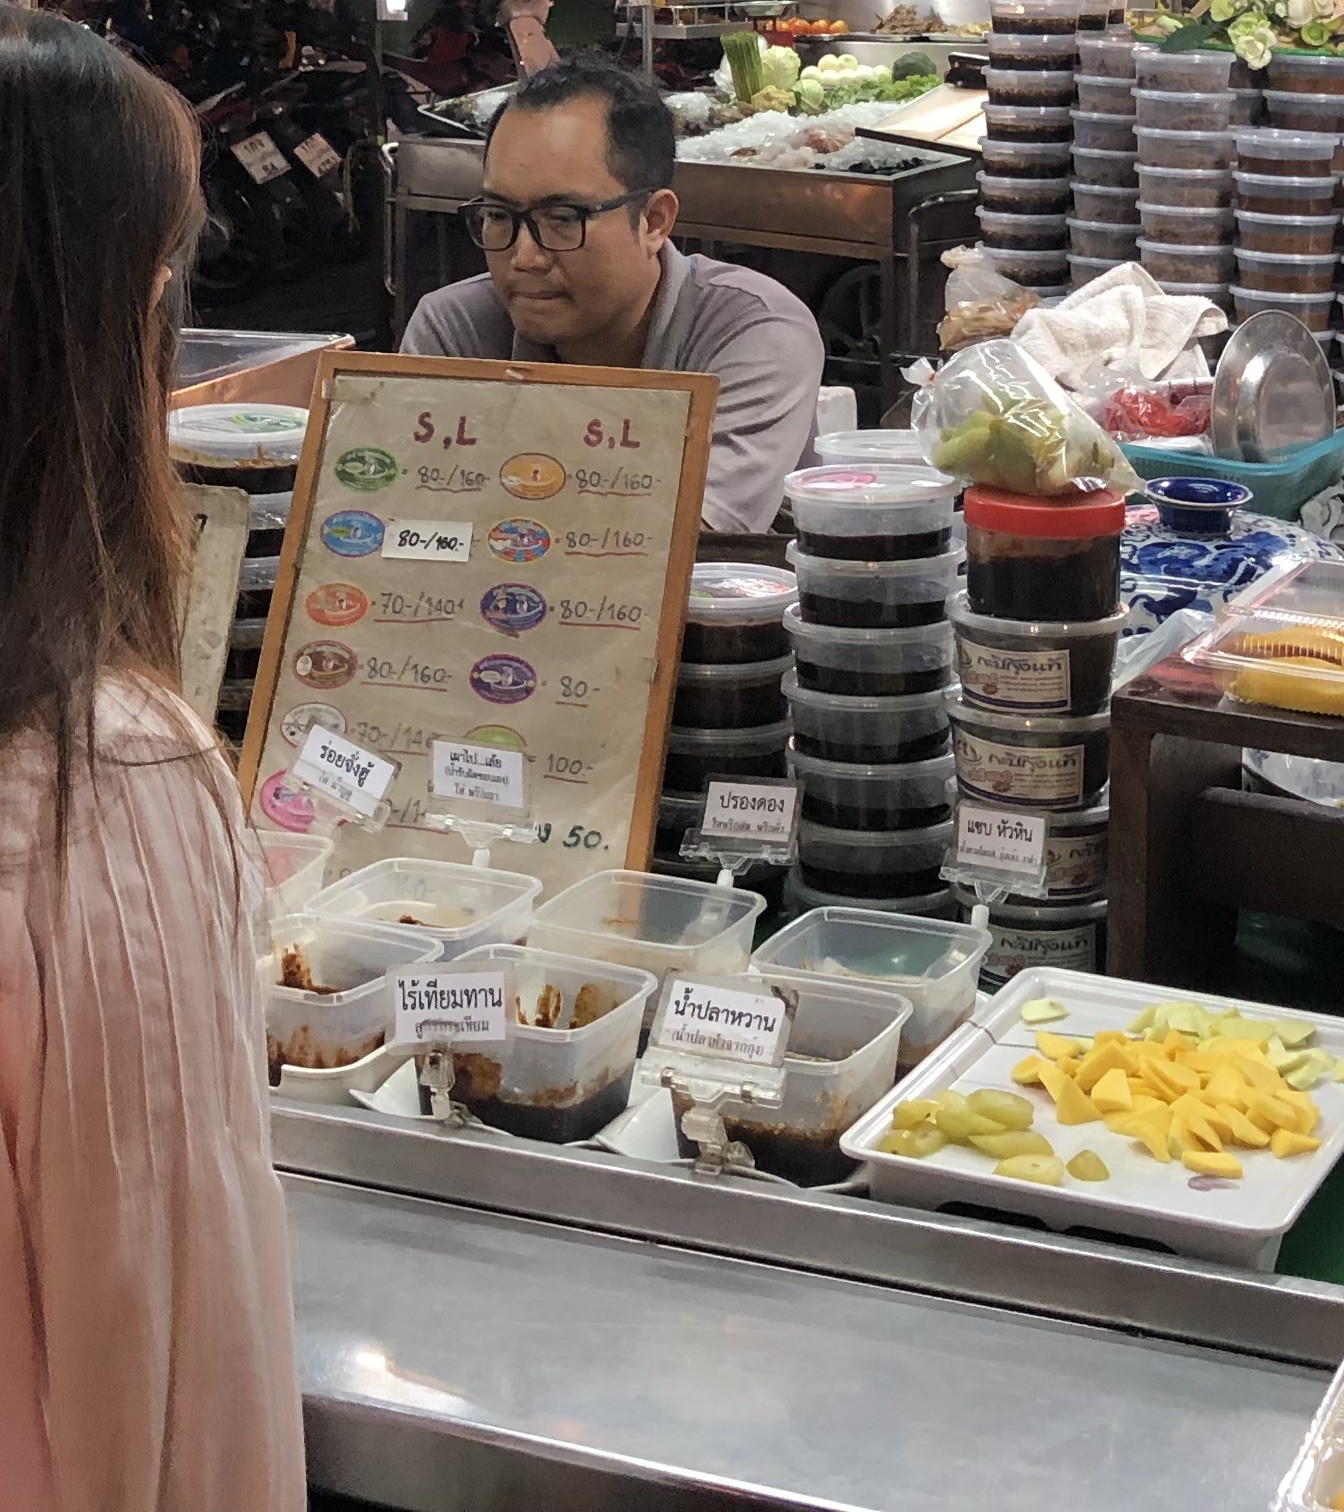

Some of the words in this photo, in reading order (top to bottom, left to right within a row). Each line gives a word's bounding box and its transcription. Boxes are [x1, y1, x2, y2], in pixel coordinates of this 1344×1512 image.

[719, 790, 785, 813] ปรองดอง
[996, 818, 1034, 843] หัวหิน
[397, 978, 503, 1011] ไร้เทียมทาน
[674, 986, 778, 1033] น้ำปลาหวาน
